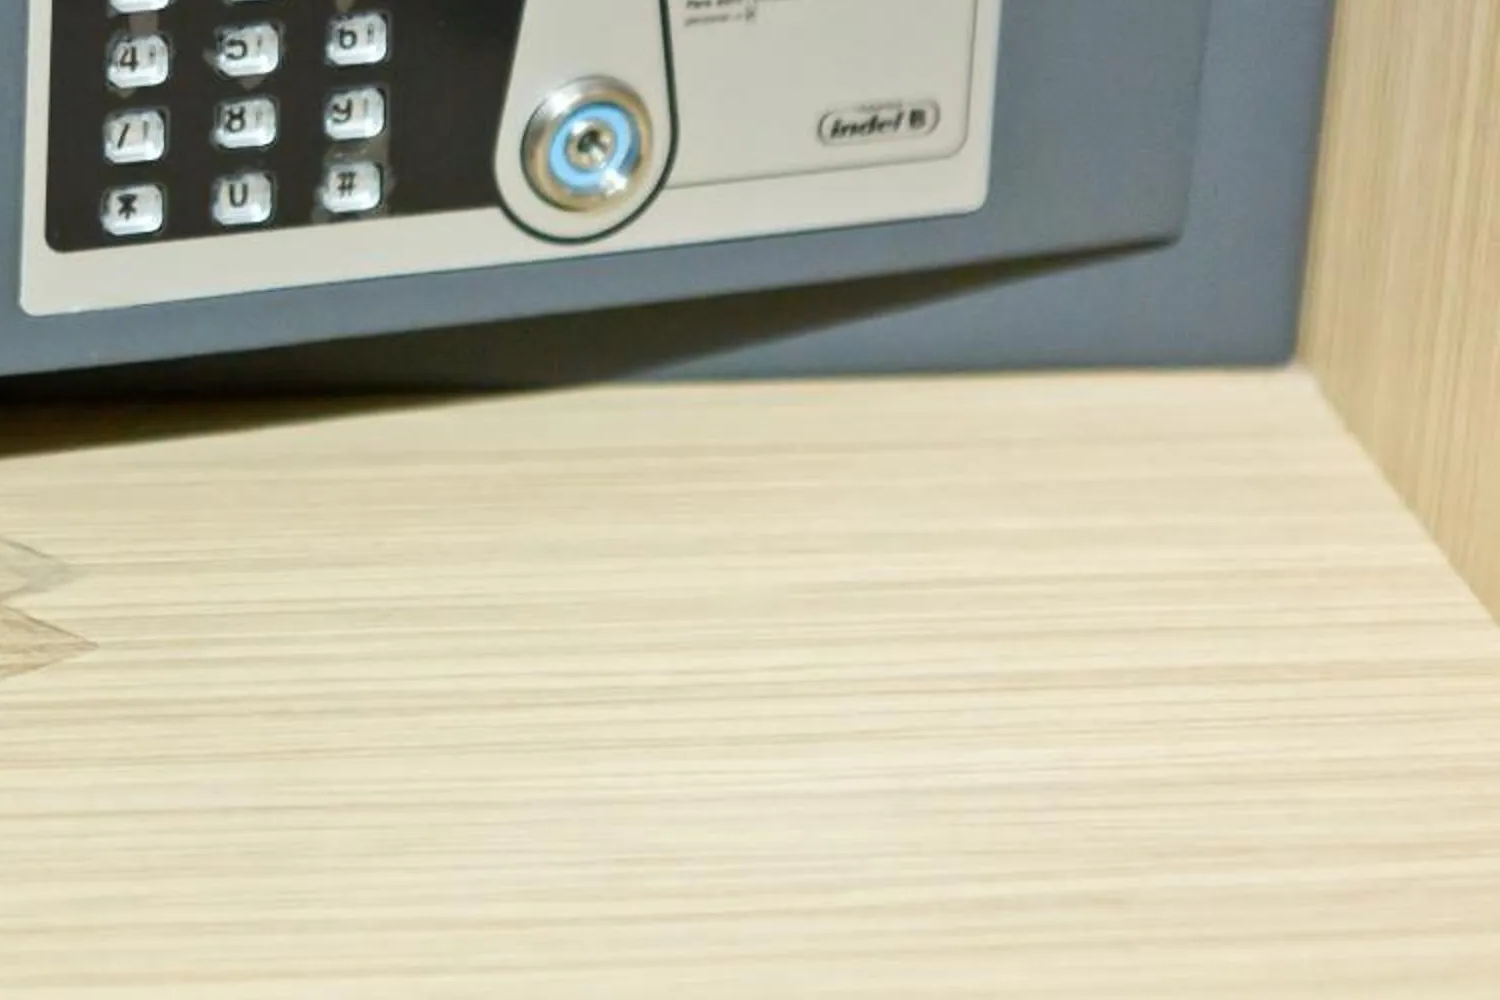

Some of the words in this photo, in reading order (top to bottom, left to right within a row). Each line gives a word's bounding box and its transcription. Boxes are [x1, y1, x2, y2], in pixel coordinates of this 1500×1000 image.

[119, 44, 138, 72] 4
[224, 39, 248, 61] 5
[338, 26, 357, 50] 6
[225, 107, 246, 133] 8
[331, 101, 352, 125] 9
